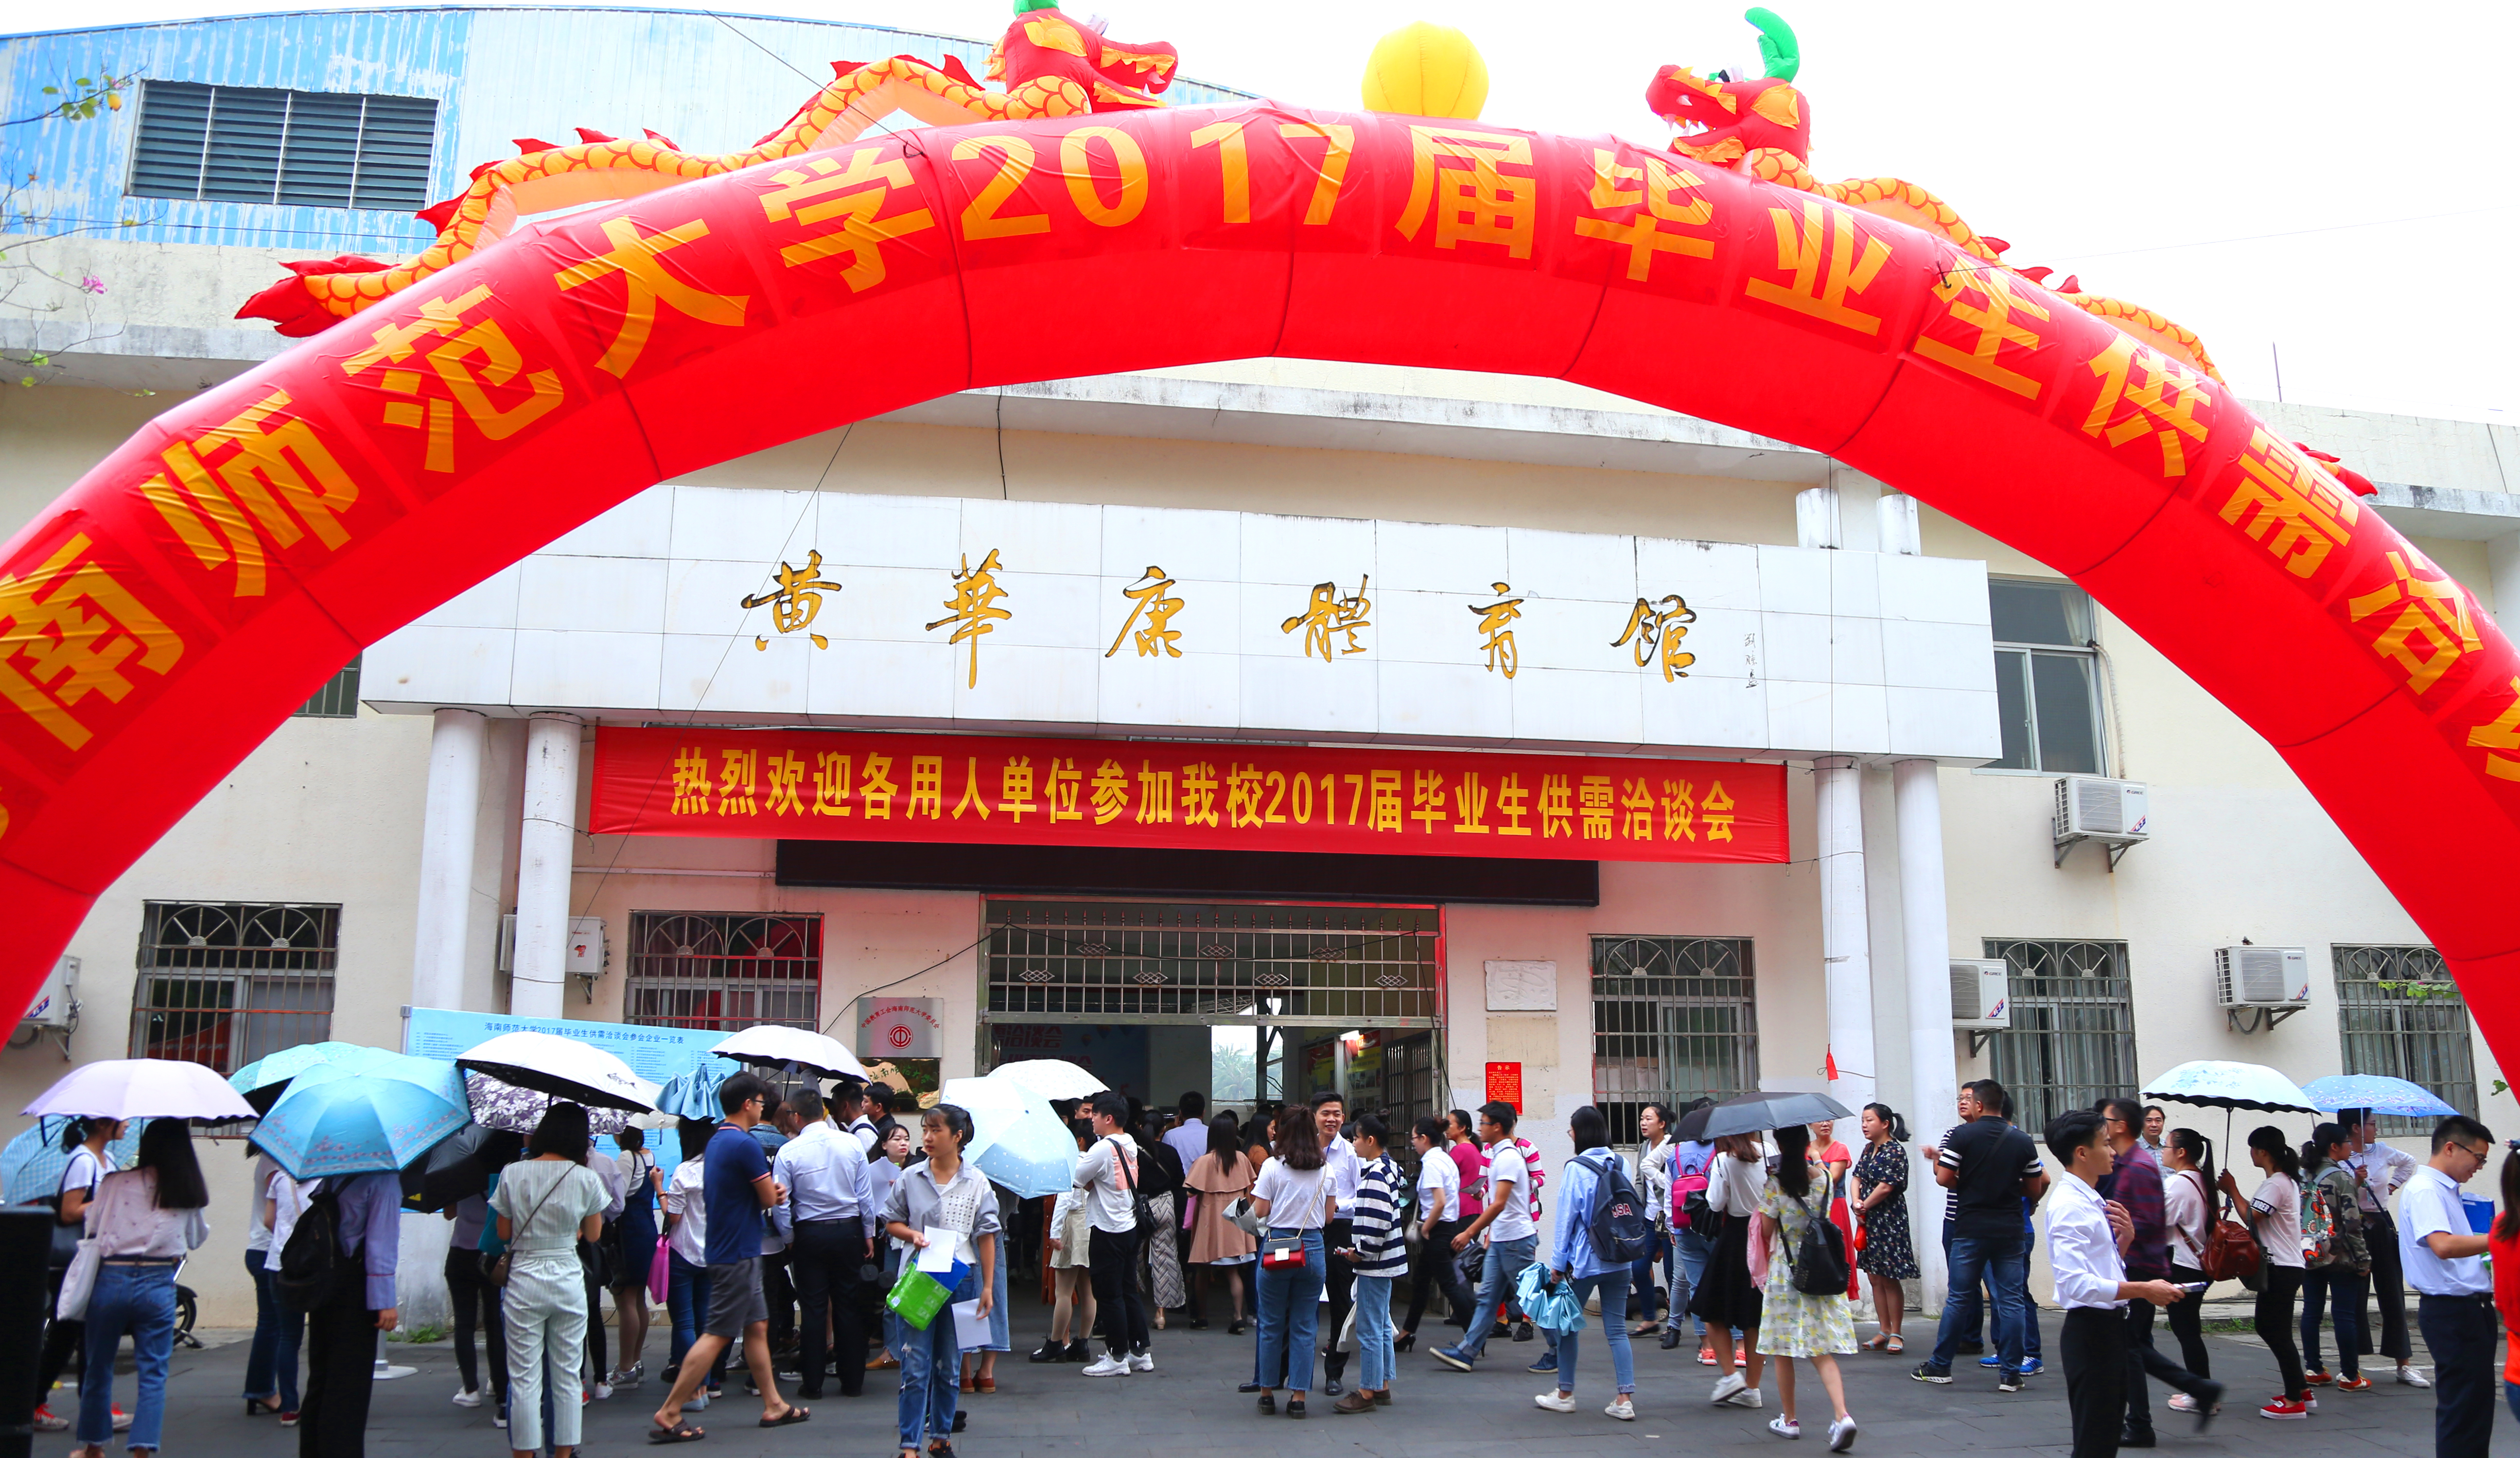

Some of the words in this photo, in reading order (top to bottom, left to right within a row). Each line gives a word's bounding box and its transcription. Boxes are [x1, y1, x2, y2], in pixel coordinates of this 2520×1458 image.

[0, 122, 2520, 842] 南师范大学2017届毕业生供需洽
[671, 746, 1735, 843] 热烈欢迎各用人单位参加我校2017届毕业生供需洽谈会
[860, 1005, 941, 1029] 中国教育工会海南师范大学委员会
[1611, 1203, 1633, 1218] USA
